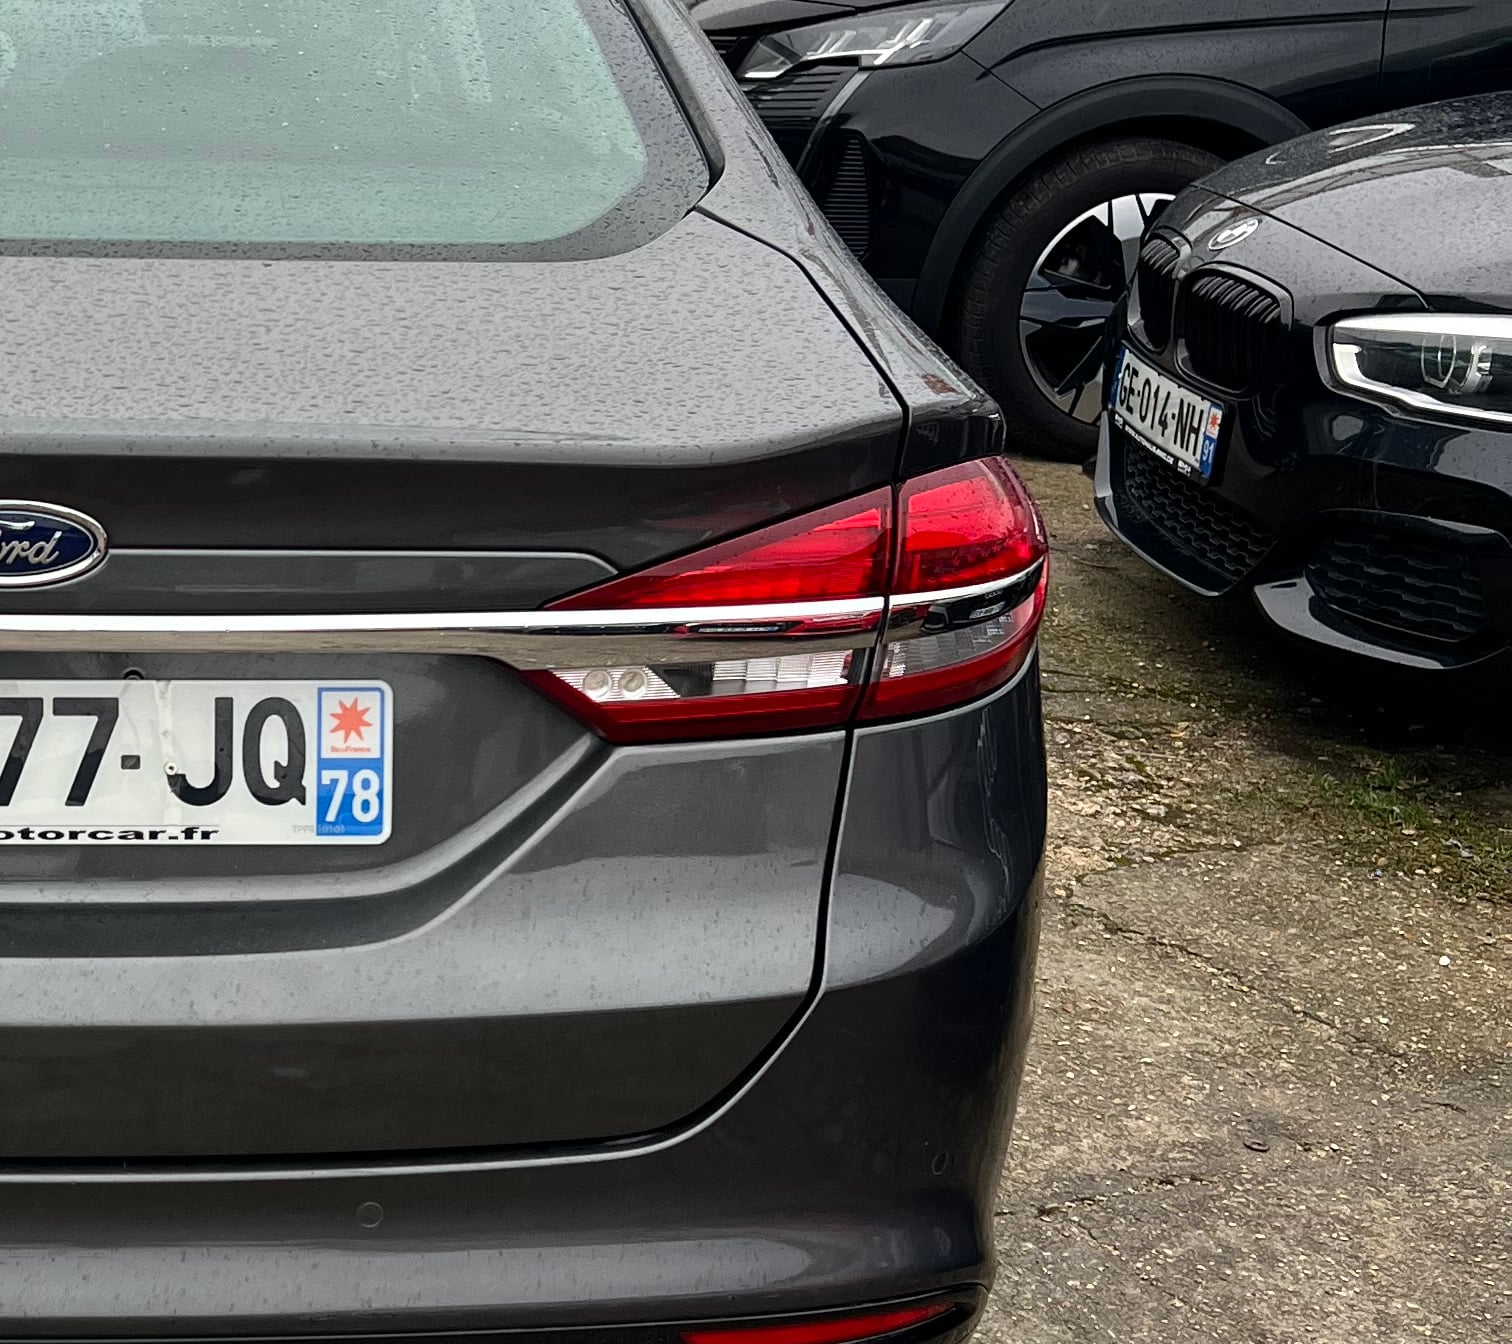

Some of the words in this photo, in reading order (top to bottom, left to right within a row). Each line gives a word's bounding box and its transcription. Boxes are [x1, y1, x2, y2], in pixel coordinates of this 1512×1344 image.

[1118, 362, 1204, 457] GE-014-NH
[1202, 439, 1214, 464] 91
[320, 769, 380, 823] 78
